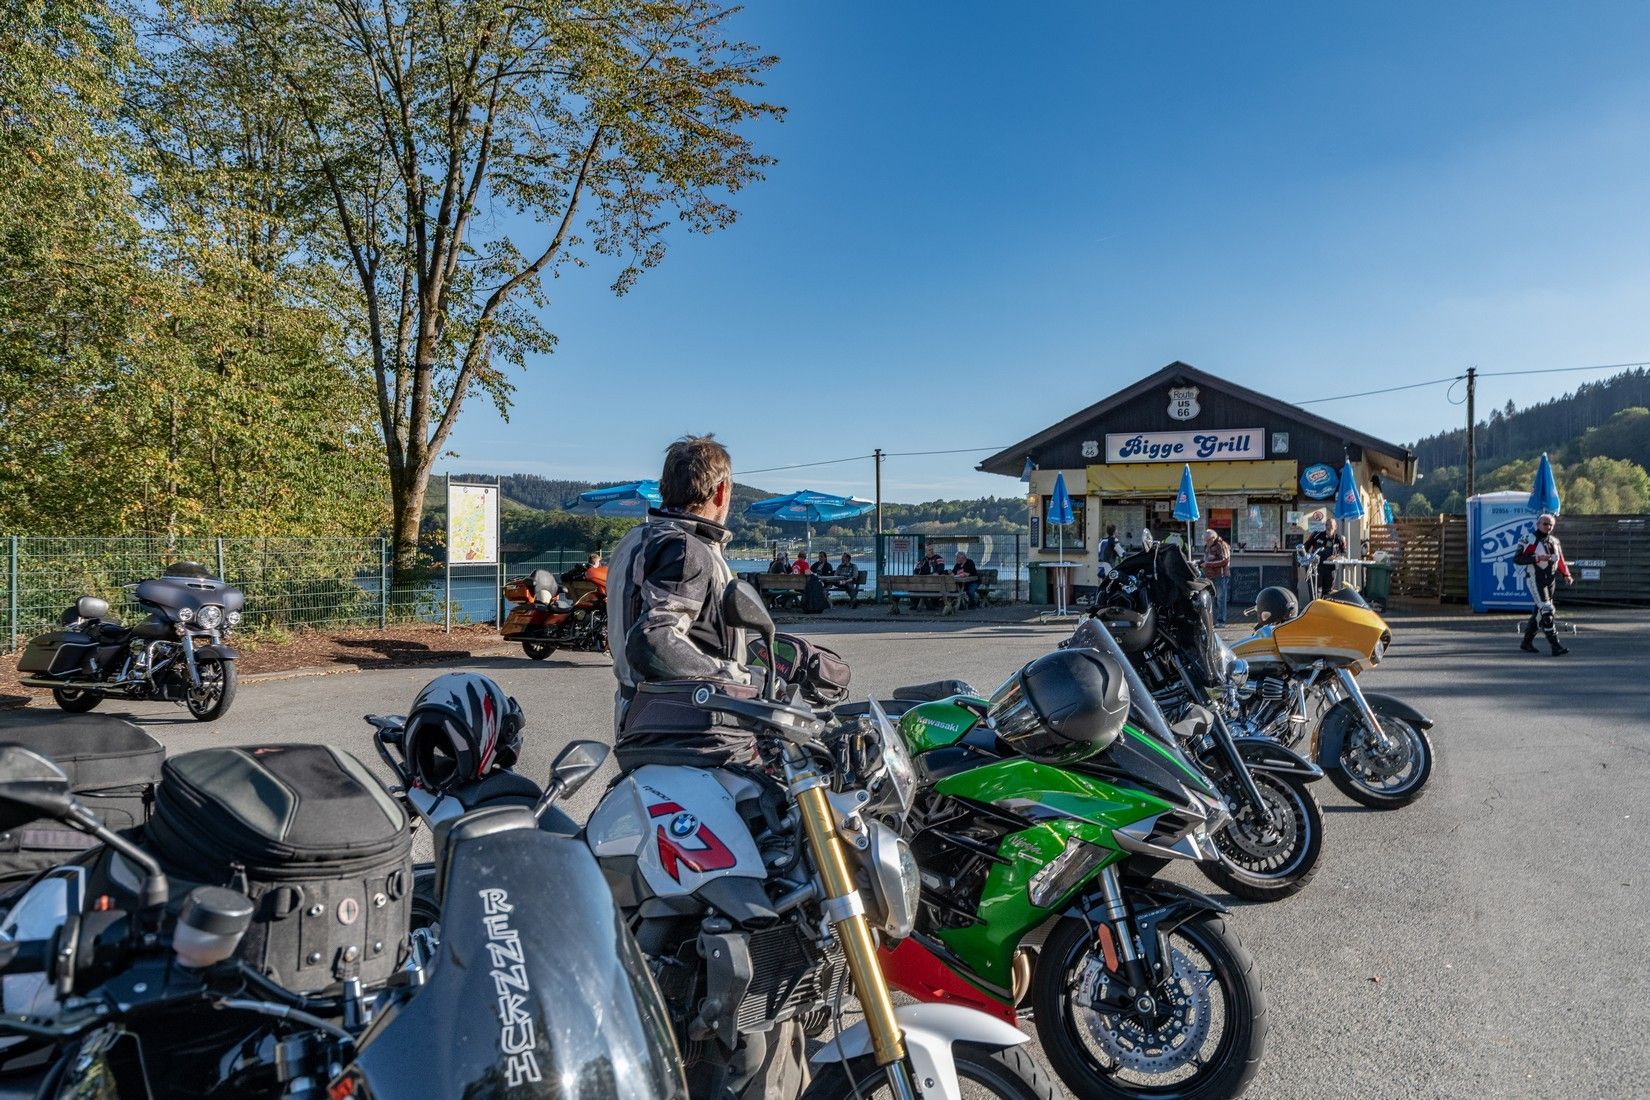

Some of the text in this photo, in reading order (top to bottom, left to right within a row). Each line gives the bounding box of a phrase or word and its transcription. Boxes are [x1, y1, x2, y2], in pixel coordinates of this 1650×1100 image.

[1173, 390, 1195, 399] Route
[1177, 408, 1190, 417] 66
[1119, 435, 1251, 458] Bigge Grill
[916, 716, 959, 732] Kawasaki
[478, 888, 543, 1087] RENNKUH
